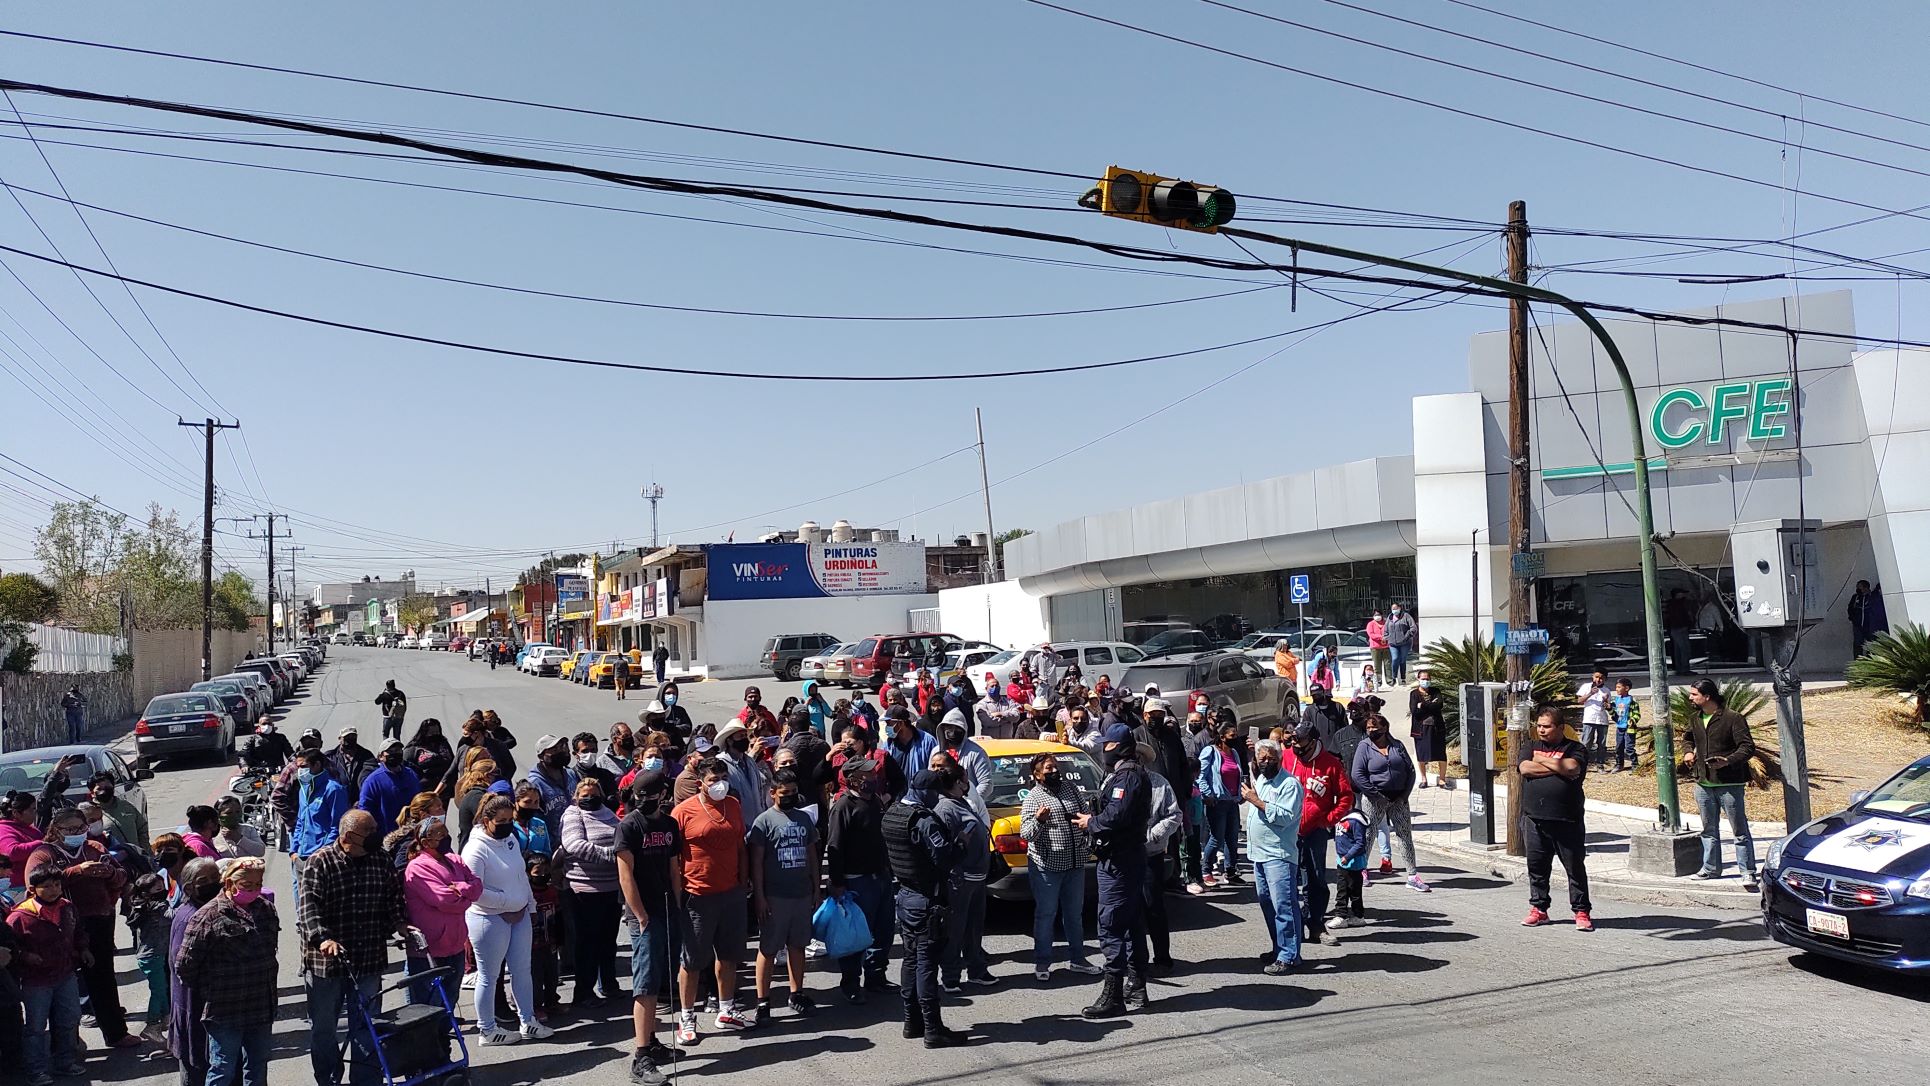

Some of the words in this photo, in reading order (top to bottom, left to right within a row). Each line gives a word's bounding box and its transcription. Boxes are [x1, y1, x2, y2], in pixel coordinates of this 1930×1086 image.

[1649, 378, 1792, 449] CFE
[824, 547, 877, 558] PINTURAS
[825, 557, 878, 570] URDIÑOLA
[1554, 600, 1574, 610] CFE
[1506, 630, 1545, 638] TAROT
[642, 832, 673, 848] AERO
